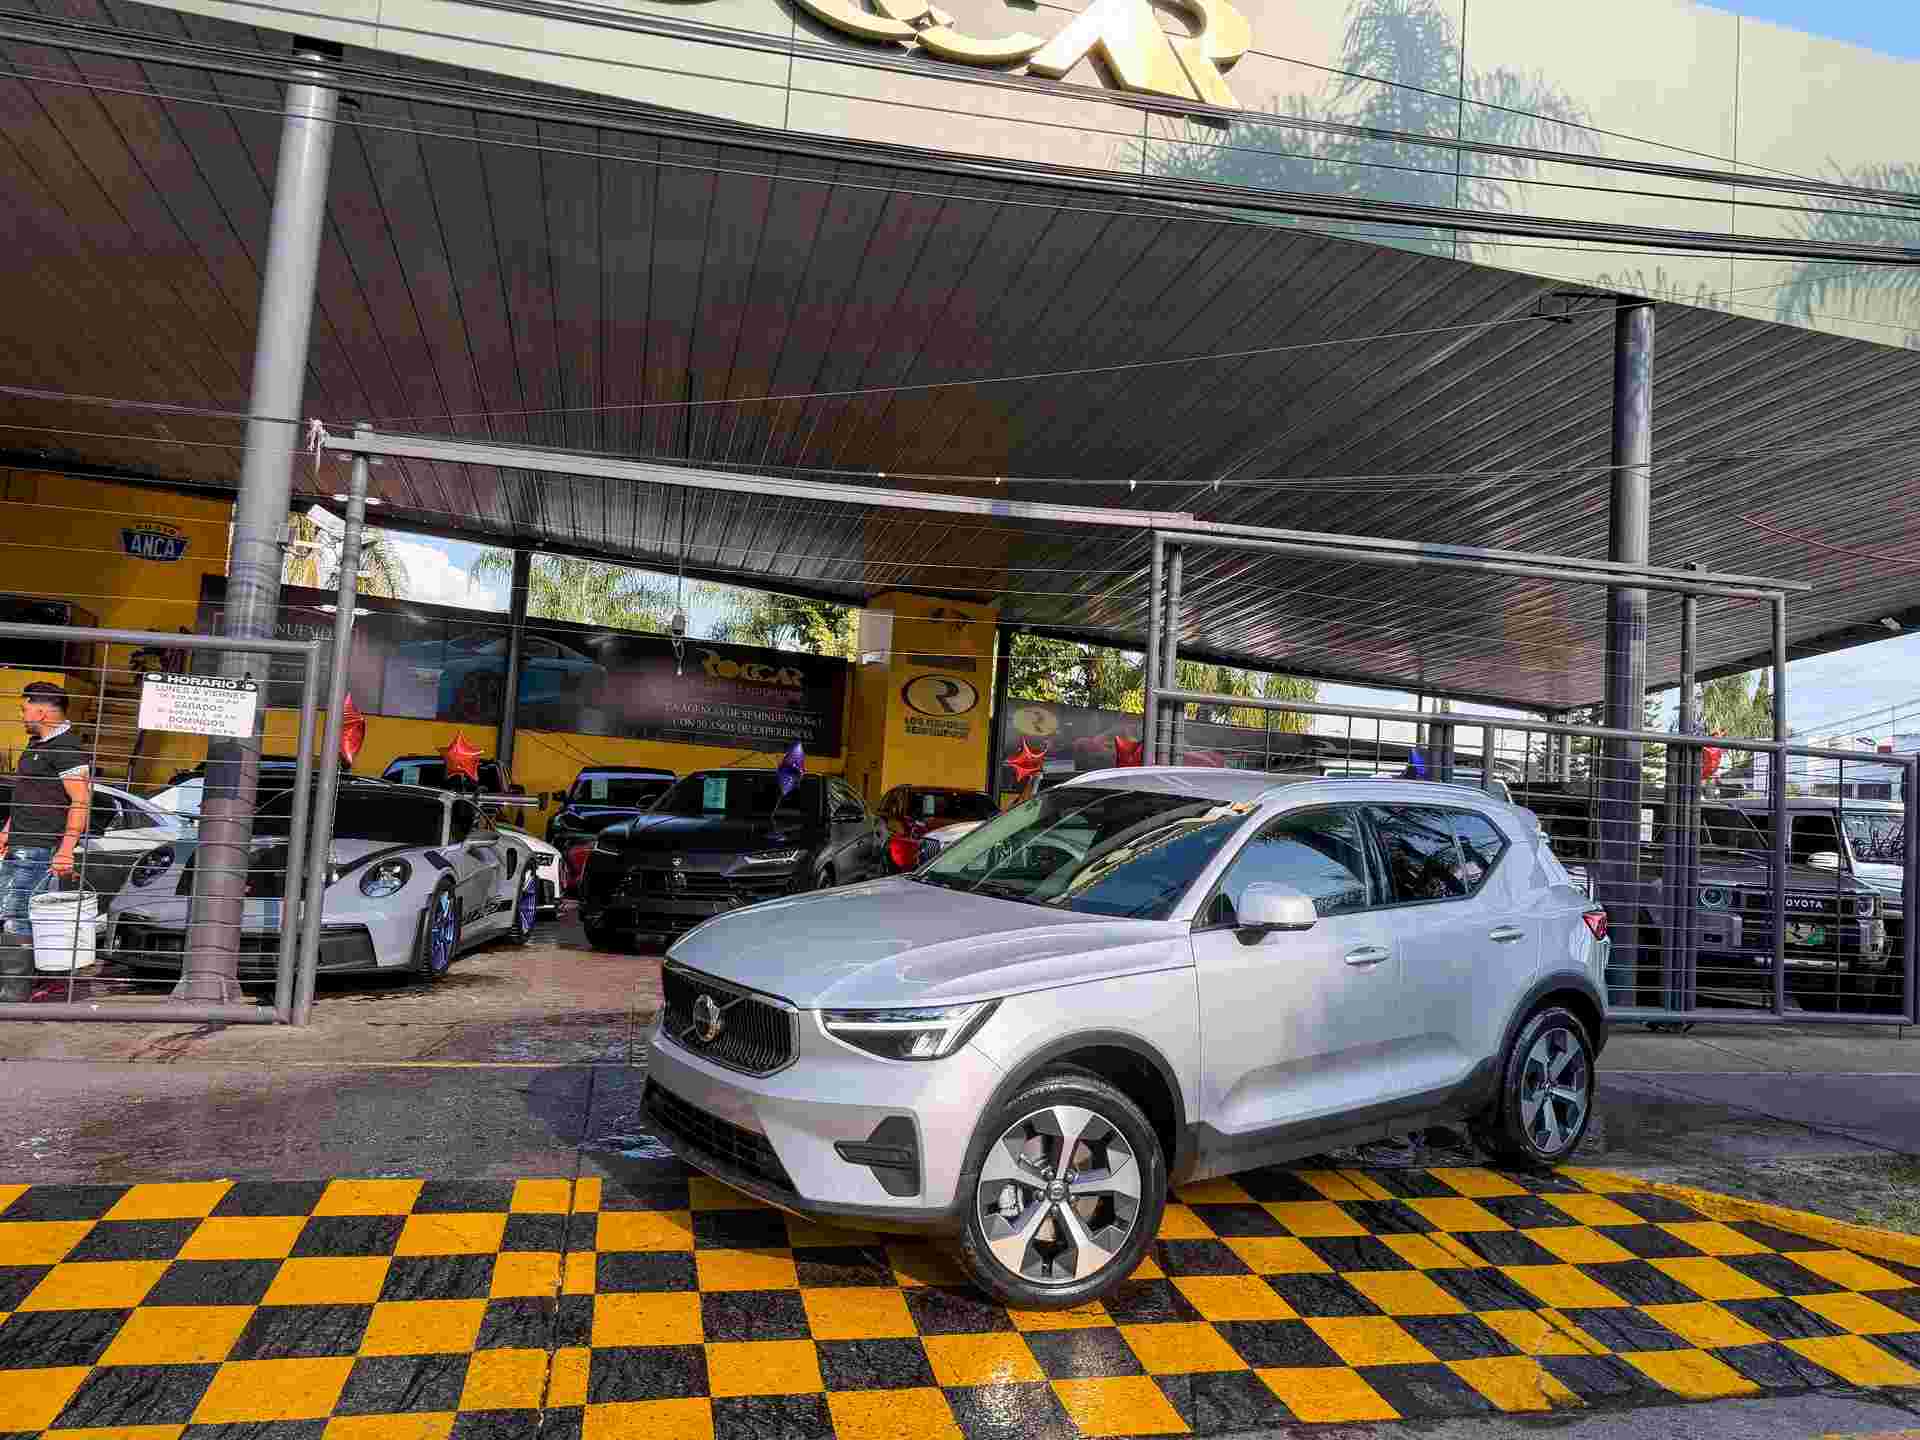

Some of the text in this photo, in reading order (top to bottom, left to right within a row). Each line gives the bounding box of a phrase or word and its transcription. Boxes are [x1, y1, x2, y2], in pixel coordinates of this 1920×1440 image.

[167, 674, 237, 689] HORARIO
[168, 716, 225, 728] DOMINGOS
[1785, 898, 1823, 909] OYOTA
